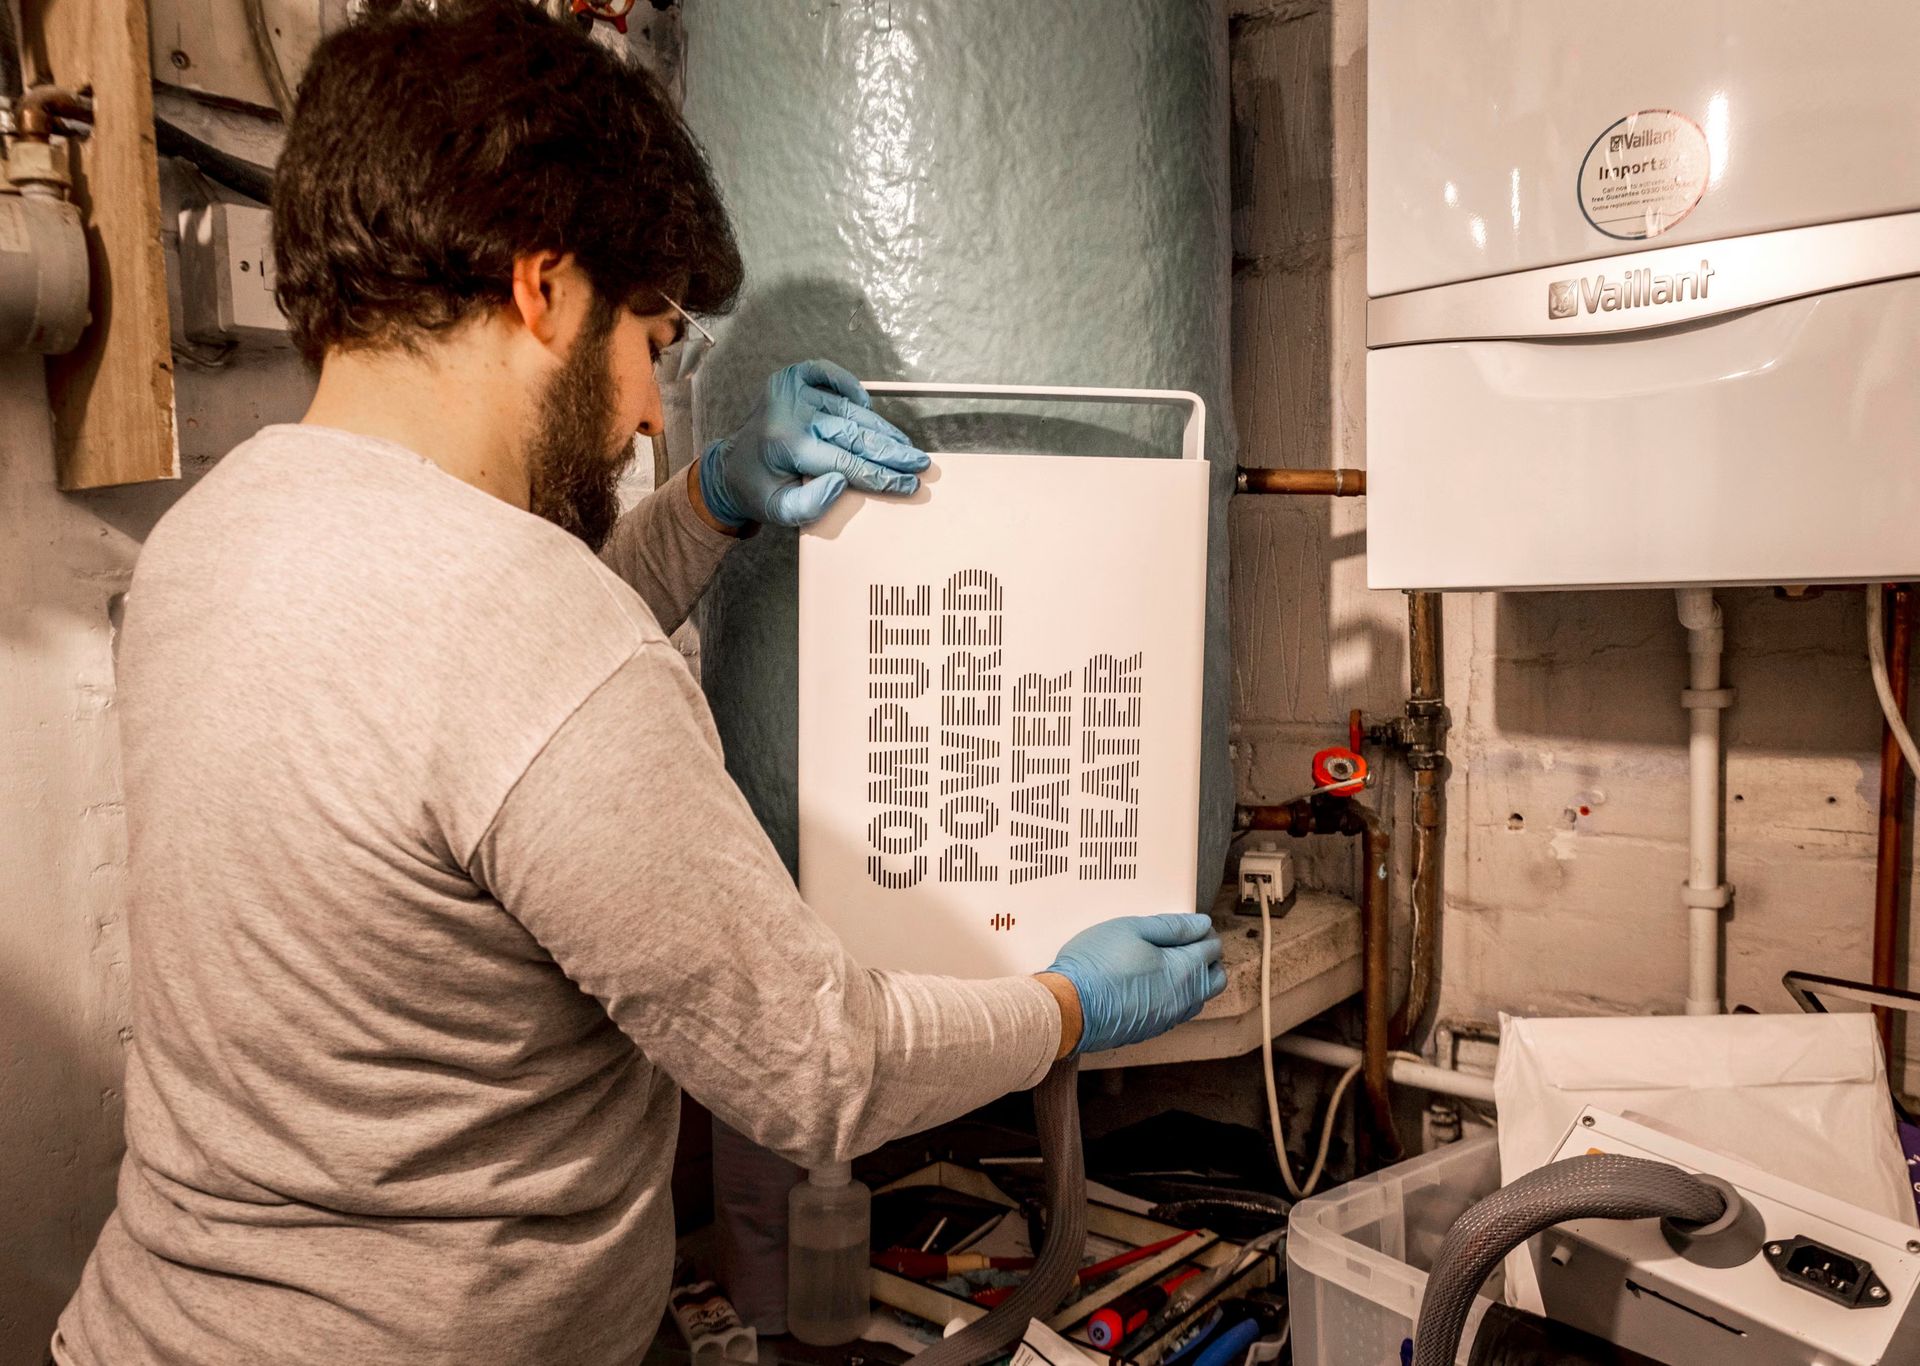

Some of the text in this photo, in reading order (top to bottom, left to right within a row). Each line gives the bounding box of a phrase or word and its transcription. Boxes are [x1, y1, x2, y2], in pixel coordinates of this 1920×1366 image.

[1581, 259, 1715, 314] Vaillant
[868, 584, 930, 889] COMPUTE
[939, 569, 1003, 882] POWERED
[1009, 670, 1072, 886] WATER
[1079, 651, 1143, 880] HEATER
